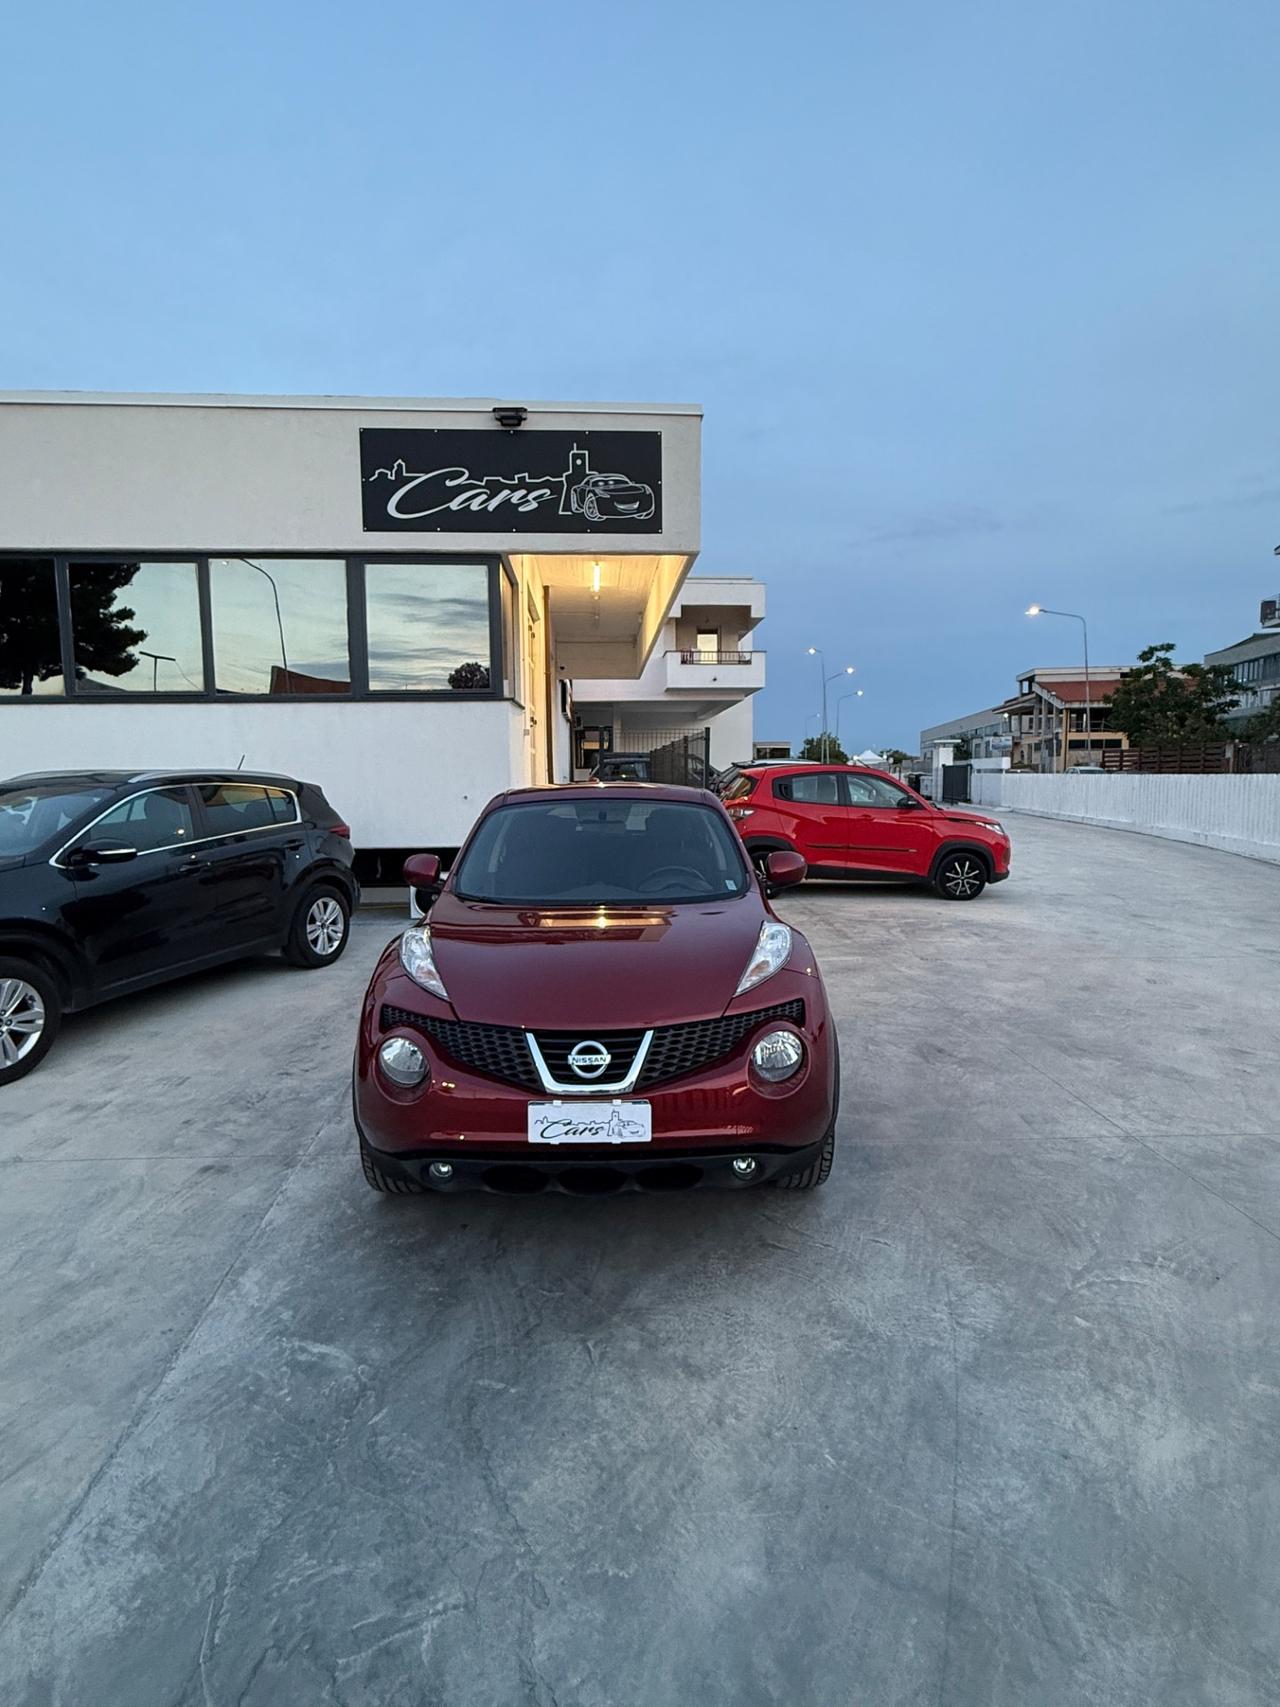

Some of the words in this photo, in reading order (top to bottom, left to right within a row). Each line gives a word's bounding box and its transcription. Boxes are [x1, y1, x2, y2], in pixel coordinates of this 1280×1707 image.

[387, 467, 558, 519] Cars
[572, 1056, 607, 1064] NISSAN
[540, 1118, 605, 1139] Cars
